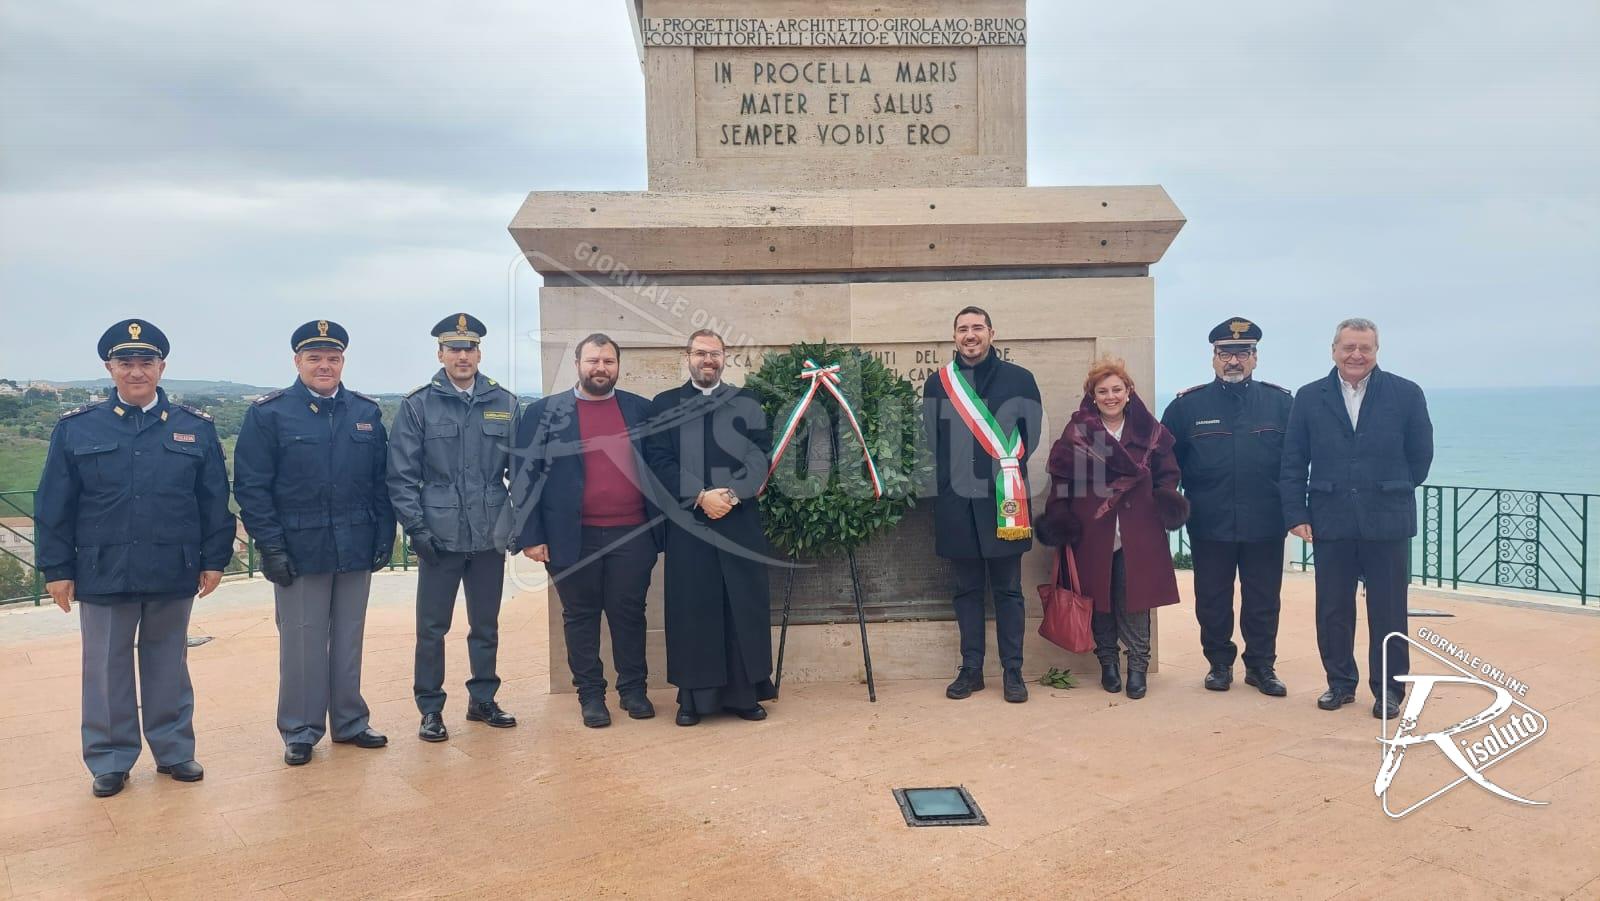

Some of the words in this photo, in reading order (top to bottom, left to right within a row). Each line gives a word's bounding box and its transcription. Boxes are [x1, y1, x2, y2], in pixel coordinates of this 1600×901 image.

[643, 19, 657, 32] IL
[663, 19, 765, 32] PROGETTISTA
[776, 19, 878, 32] ARCHITETTO
[884, 18, 968, 31] GIROLAMO
[974, 18, 1026, 31] BRUNO
[651, 32, 761, 45] COSTRUTTORI
[811, 32, 875, 45] IGNAZIO
[880, 32, 889, 45] E
[895, 32, 973, 45] VINCENZO
[976, 31, 1026, 44] ARENA
[714, 62, 732, 84] IN
[754, 62, 871, 84] PROCELLA
[895, 61, 958, 83] MARIS
[740, 93, 808, 115] MATER
[829, 93, 849, 114] ET
[873, 92, 934, 114] SALUS
[720, 125, 797, 146] SEMPER
[816, 125, 885, 145] VOBIS
[907, 124, 951, 145] ERO
[915, 350, 939, 364] DEL
